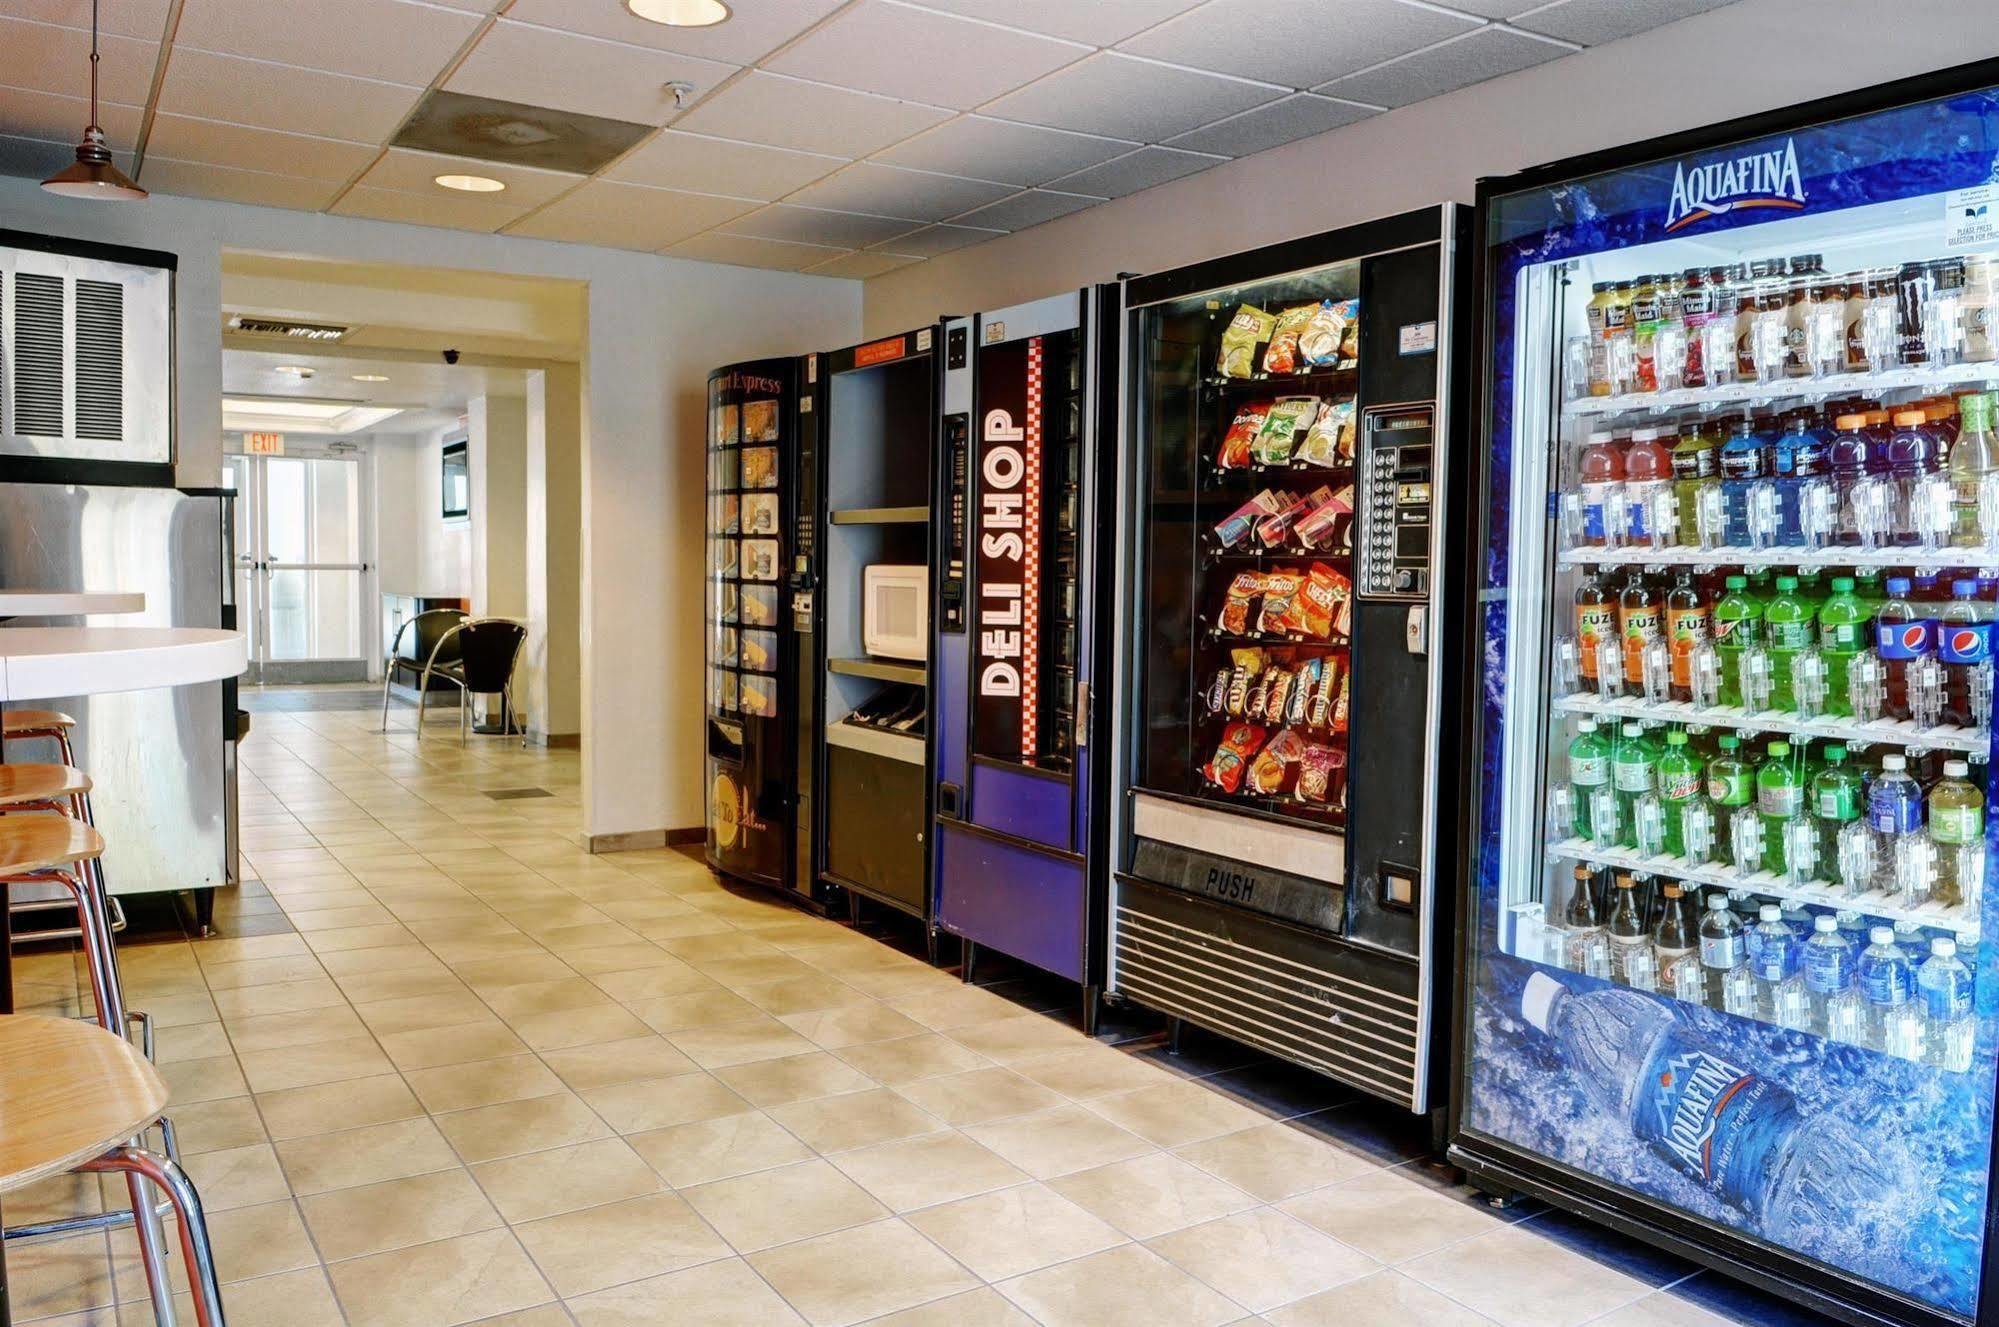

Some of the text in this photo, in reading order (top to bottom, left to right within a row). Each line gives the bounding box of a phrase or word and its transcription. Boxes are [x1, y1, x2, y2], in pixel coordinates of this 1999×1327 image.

[1664, 137, 1806, 229] AQUAFINA
[733, 371, 783, 394] Express
[253, 431, 278, 452] EXIT
[981, 408, 1024, 697] DELI SHOP
[1205, 868, 1255, 902] PUSH
[1662, 1050, 1746, 1179] AQUAFINA
[1730, 1099, 1754, 1133] Perfect
